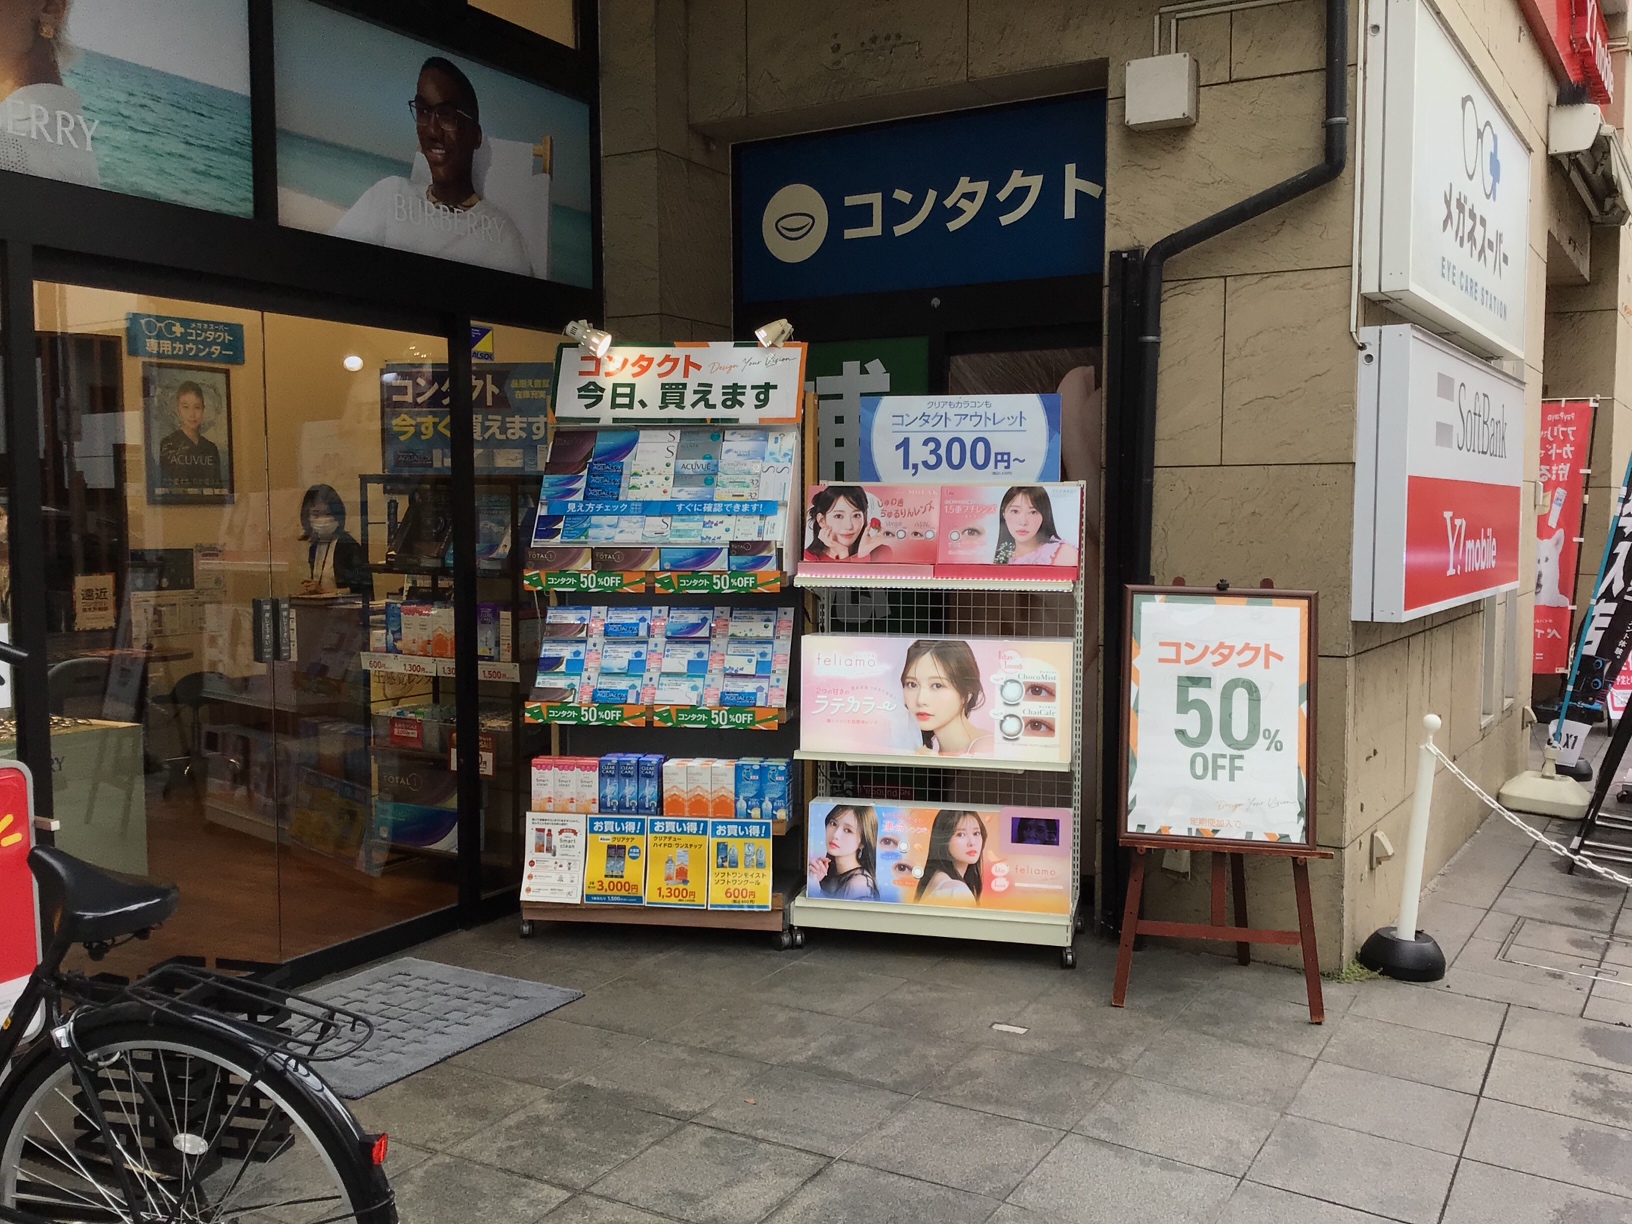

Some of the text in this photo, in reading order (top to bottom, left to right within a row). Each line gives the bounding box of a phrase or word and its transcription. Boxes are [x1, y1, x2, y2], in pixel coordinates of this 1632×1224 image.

[844, 163, 1104, 239] コンタクト
[394, 193, 505, 244] BURBERRY
[1442, 182, 1509, 280] メガネスーパー
[1441, 256, 1507, 321] EYE CARE STATION
[186, 329, 234, 344] コンタクト
[145, 338, 234, 358] 専用カウンター
[578, 354, 703, 378] コンタクト
[708, 361, 738, 374] Design
[741, 357, 762, 372] Your
[576, 381, 778, 410] 今日、買えます
[927, 400, 992, 409] クリアもカラコンも
[1457, 382, 1507, 459] SoftBank
[170, 455, 214, 466] ACUVUE
[681, 462, 712, 471] ACUVUE
[566, 502, 628, 513] 見え方チェック
[547, 577, 577, 585] コンタクト
[679, 578, 710, 587] コンタクト
[816, 652, 876, 668] feliamo
[1157, 641, 1285, 669] コンタクト
[1017, 673, 1057, 681] ChocoMist
[815, 687, 850, 695] 2つの甘さの
[548, 710, 578, 718] コンタクト
[678, 713, 708, 721] コンタクト
[1189, 752, 1245, 782] OFF
[1190, 817, 1242, 828] 定期便加入で
[1015, 864, 1056, 876] feliamo
[597, 880, 639, 893] 3,000円
[657, 887, 696, 899] 1,300円
[725, 888, 756, 899] 600円
